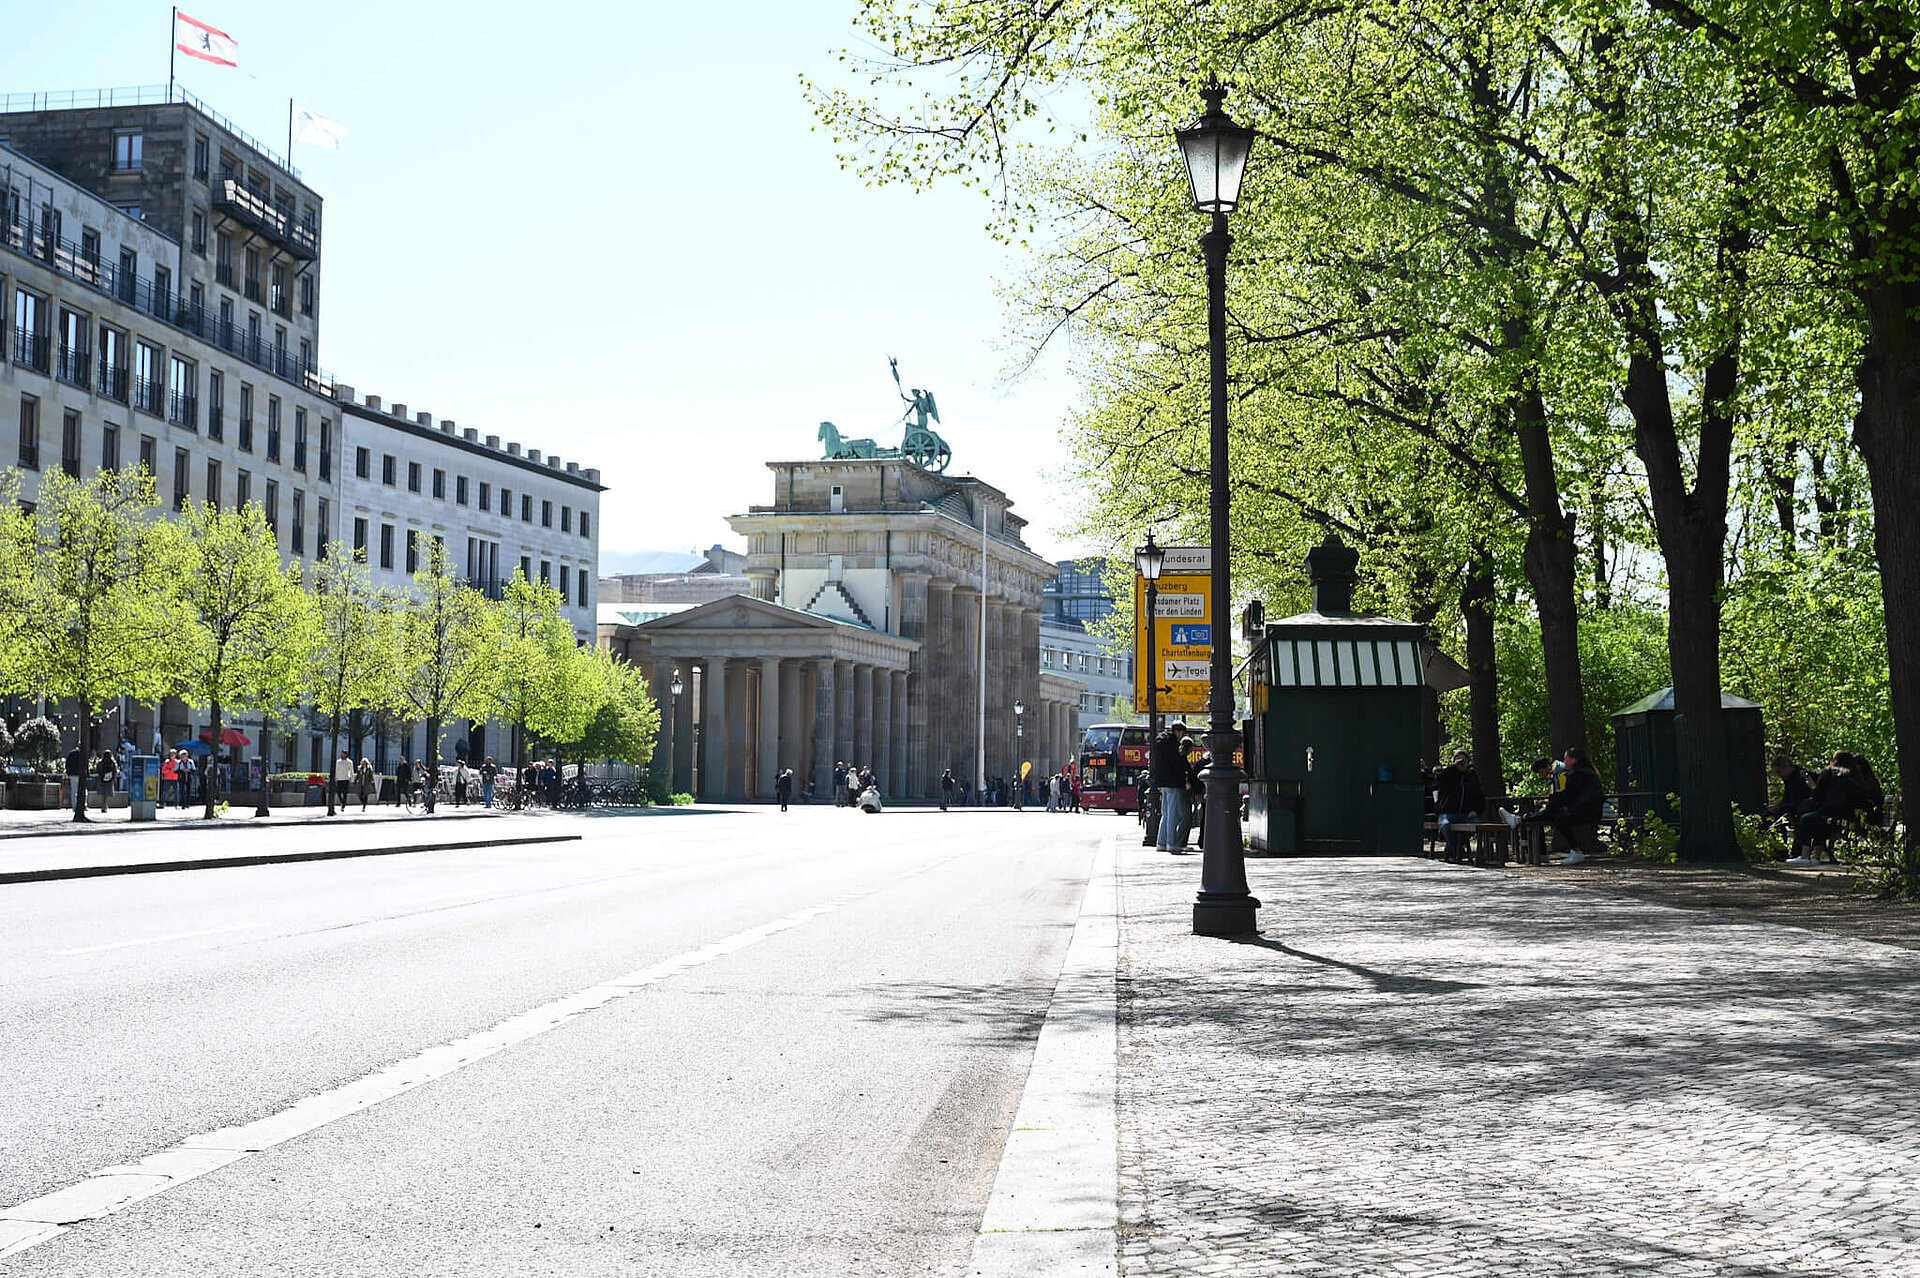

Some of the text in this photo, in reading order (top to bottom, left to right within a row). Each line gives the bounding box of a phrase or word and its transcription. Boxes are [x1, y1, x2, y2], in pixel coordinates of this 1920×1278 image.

[1165, 555, 1205, 563] undesrat
[1183, 597, 1200, 605] Platz
[1166, 607, 1179, 615] den
[1180, 607, 1202, 615] Linden
[1162, 648, 1211, 659] Charlottenburg
[1185, 666, 1208, 676] Tegel
